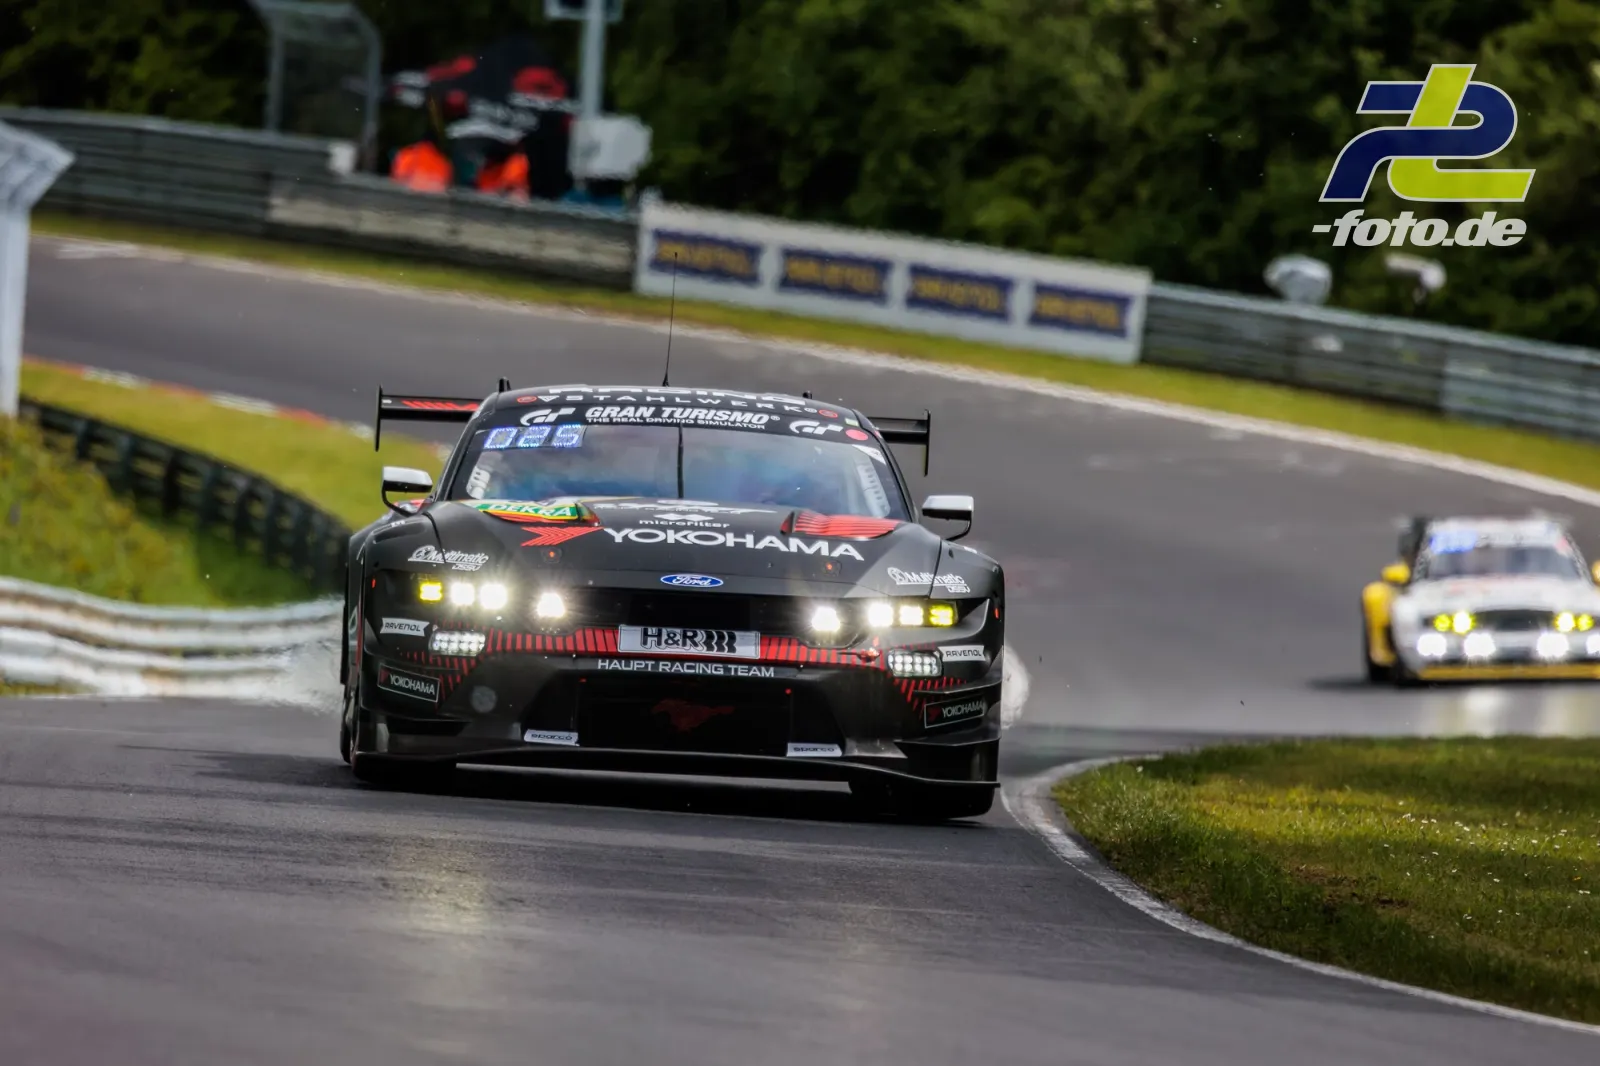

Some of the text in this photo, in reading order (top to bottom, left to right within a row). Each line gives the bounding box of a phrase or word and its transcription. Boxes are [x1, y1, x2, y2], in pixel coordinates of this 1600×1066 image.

[585, 406, 655, 418] GRAN
[697, 419, 765, 430] SIMULATOR
[488, 503, 572, 516] DEKRA
[639, 519, 730, 528] microfilter
[604, 527, 865, 561] YOKOHAMA
[671, 575, 713, 587] Ford
[385, 621, 421, 631] RAVENOL
[641, 627, 704, 651] H&R
[945, 649, 982, 657] RAVENOL
[598, 659, 775, 677] HAUPT RACING TEAM
[390, 674, 436, 695] YOKOHAMA
[942, 701, 983, 718] YOKOHAMA
